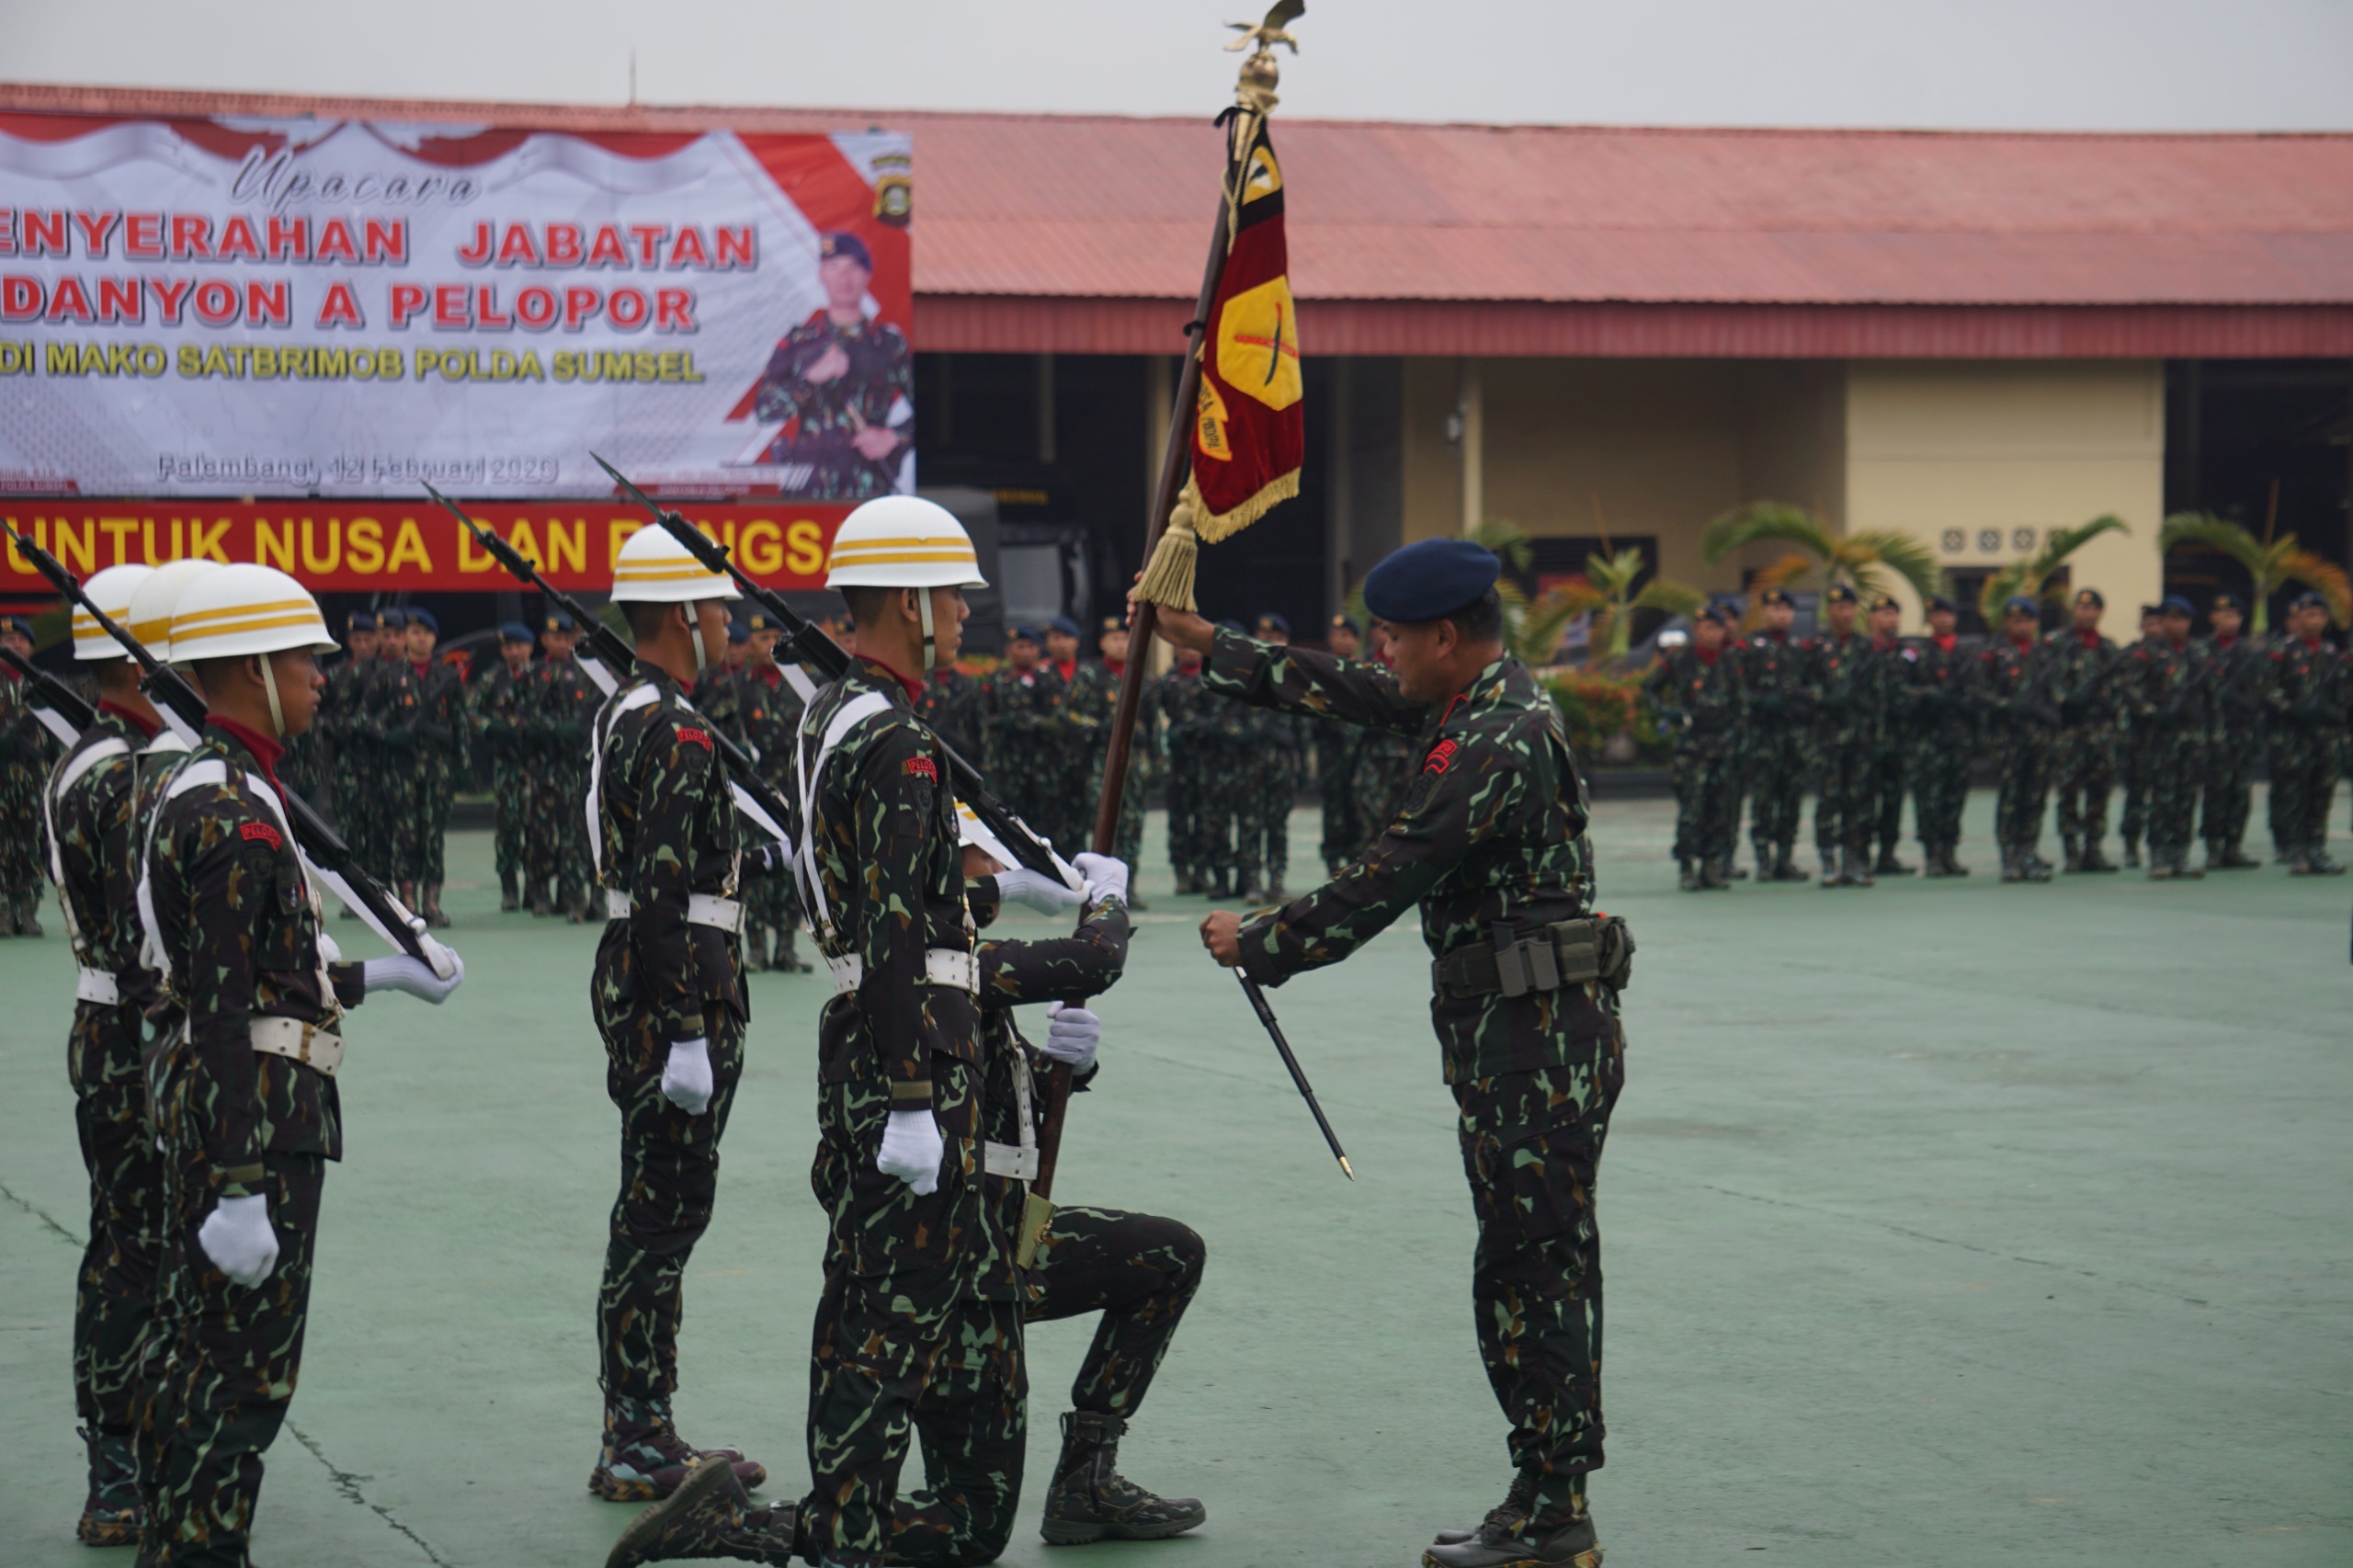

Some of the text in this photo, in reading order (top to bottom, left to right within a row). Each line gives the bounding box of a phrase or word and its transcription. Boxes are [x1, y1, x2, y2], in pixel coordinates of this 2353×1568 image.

[230, 143, 482, 215] Upacara
[457, 218, 759, 272] JABATAN
[1, 275, 699, 335] DANYON A PELOPOR
[0, 342, 706, 383] DI MAKO SATBRIMOB POLDA SUMSEL
[156, 451, 322, 488] Palembang,
[329, 451, 366, 485] 12
[370, 451, 486, 485] Februari
[6, 517, 233, 575] UNTUK
[256, 517, 433, 574] NUSA
[459, 518, 586, 574] DAN
